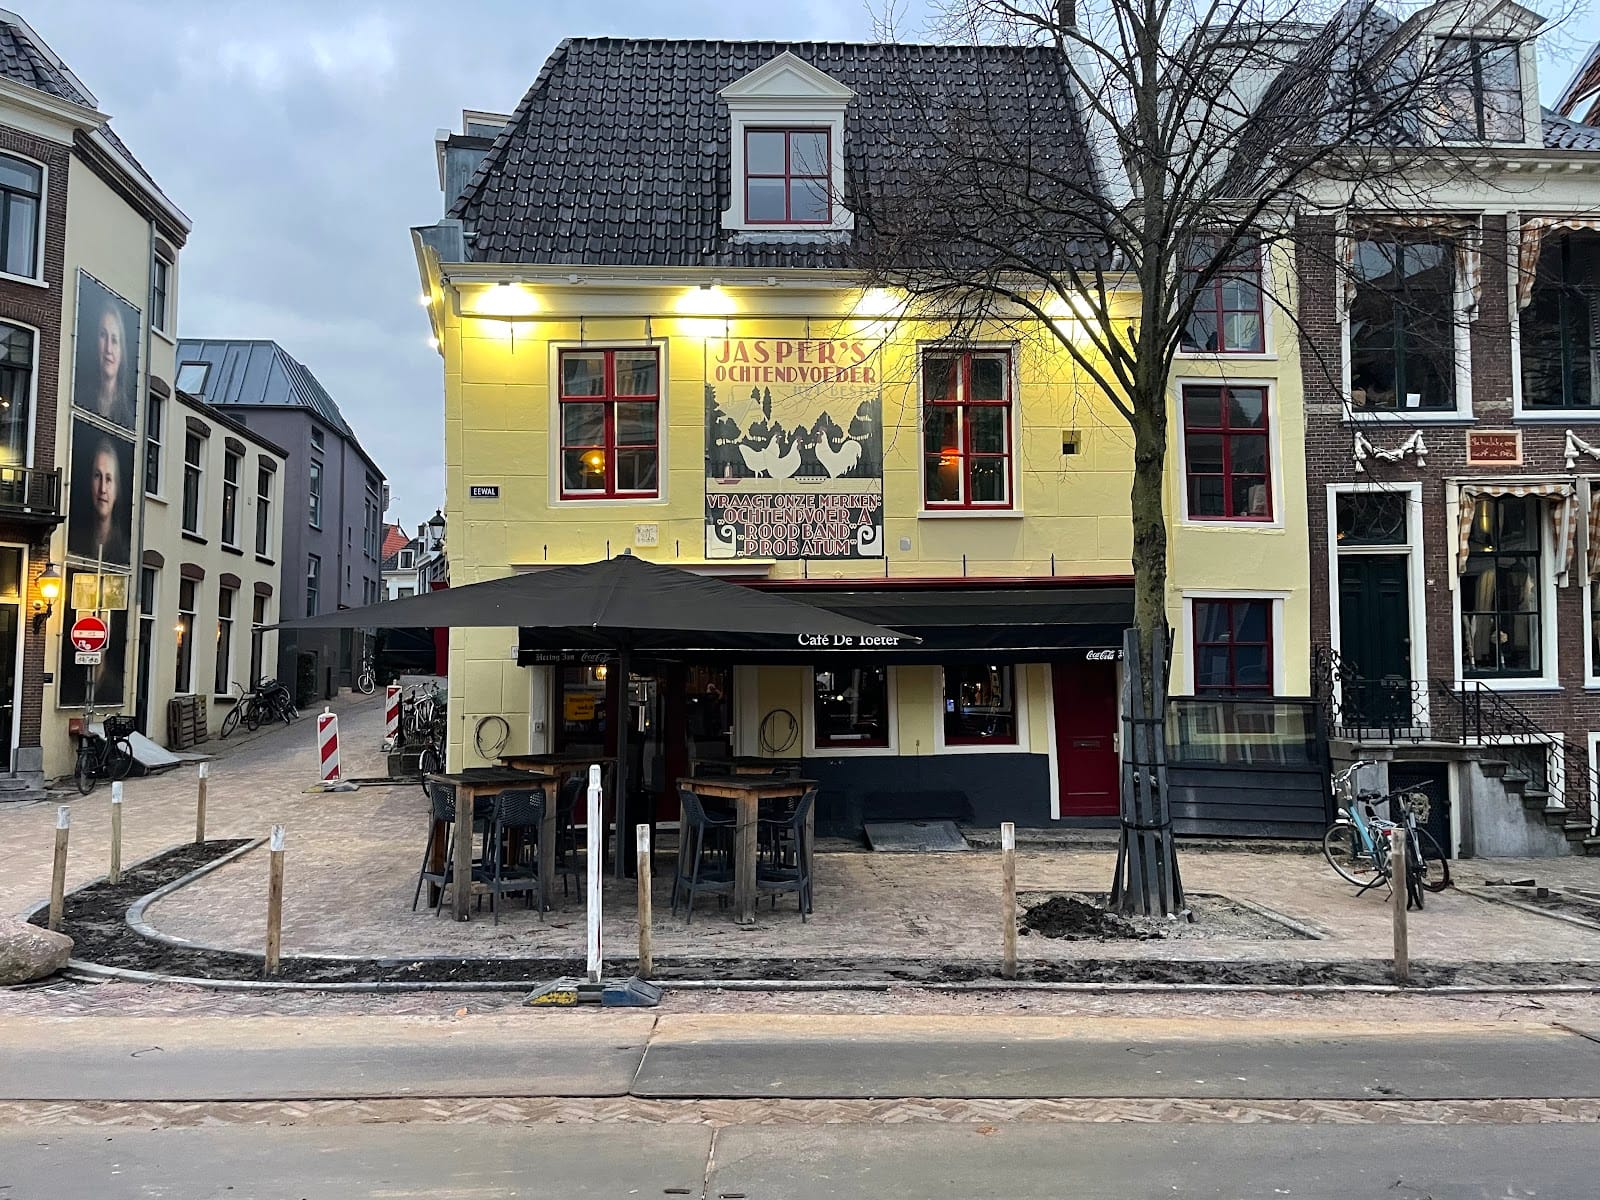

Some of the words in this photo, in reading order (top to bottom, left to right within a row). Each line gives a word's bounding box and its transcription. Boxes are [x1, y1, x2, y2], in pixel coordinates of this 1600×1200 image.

[715, 340, 866, 363] JASPER’S
[715, 365, 876, 383] OCHTENDVOEDER
[473, 487, 496, 496] EEWAL
[706, 494, 771, 508] VRAAGT
[774, 494, 815, 508] ONZE
[818, 494, 882, 509] MERKEN:
[798, 633, 829, 646] Café
[833, 634, 853, 646] De
